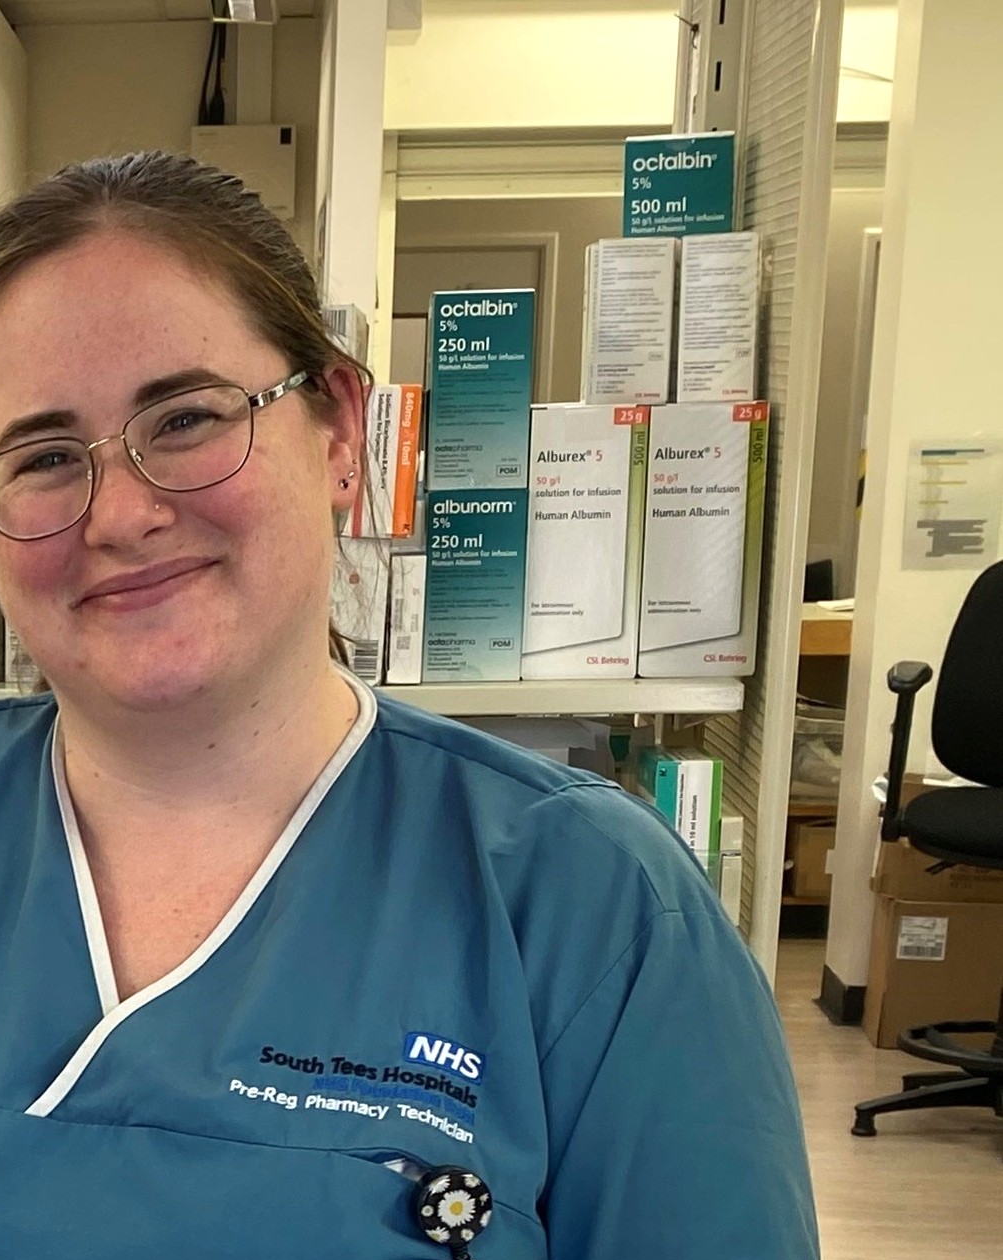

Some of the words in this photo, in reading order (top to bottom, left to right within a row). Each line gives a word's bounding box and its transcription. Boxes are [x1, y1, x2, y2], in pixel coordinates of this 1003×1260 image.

[632, 151, 717, 173] octalbin®
[632, 176, 651, 190] 5%
[631, 200, 660, 215] 500
[665, 196, 687, 212] ml
[439, 320, 458, 332] 5%
[438, 338, 466, 352] 250
[471, 337, 490, 351] ml
[402, 392, 414, 427] 840mg
[739, 408, 752, 418] 25
[755, 410, 762, 419] g
[620, 411, 633, 421] 25
[636, 413, 643, 423] g
[635, 431, 645, 444] ml
[402, 440, 411, 465] 10ml
[595, 450, 603, 461] 5
[634, 446, 644, 465] 500
[714, 447, 721, 458] 5
[536, 489, 569, 497] solution
[573, 488, 584, 496] for
[588, 487, 621, 495] infusion
[535, 511, 568, 520] Human
[571, 510, 611, 519] Albumin
[652, 508, 686, 517] Human
[689, 507, 729, 517] Albumin
[433, 517, 450, 528] 5%
[431, 535, 459, 548] 250
[464, 534, 483, 547] ml
[408, 1035, 482, 1079] NHS
[259, 1046, 324, 1075] South
[330, 1057, 377, 1080] Tees
[382, 1066, 478, 1109] Hospitals
[230, 1079, 298, 1109] Pre-Reg
[305, 1095, 389, 1120] Pharmacy
[397, 1103, 474, 1144] Technician
